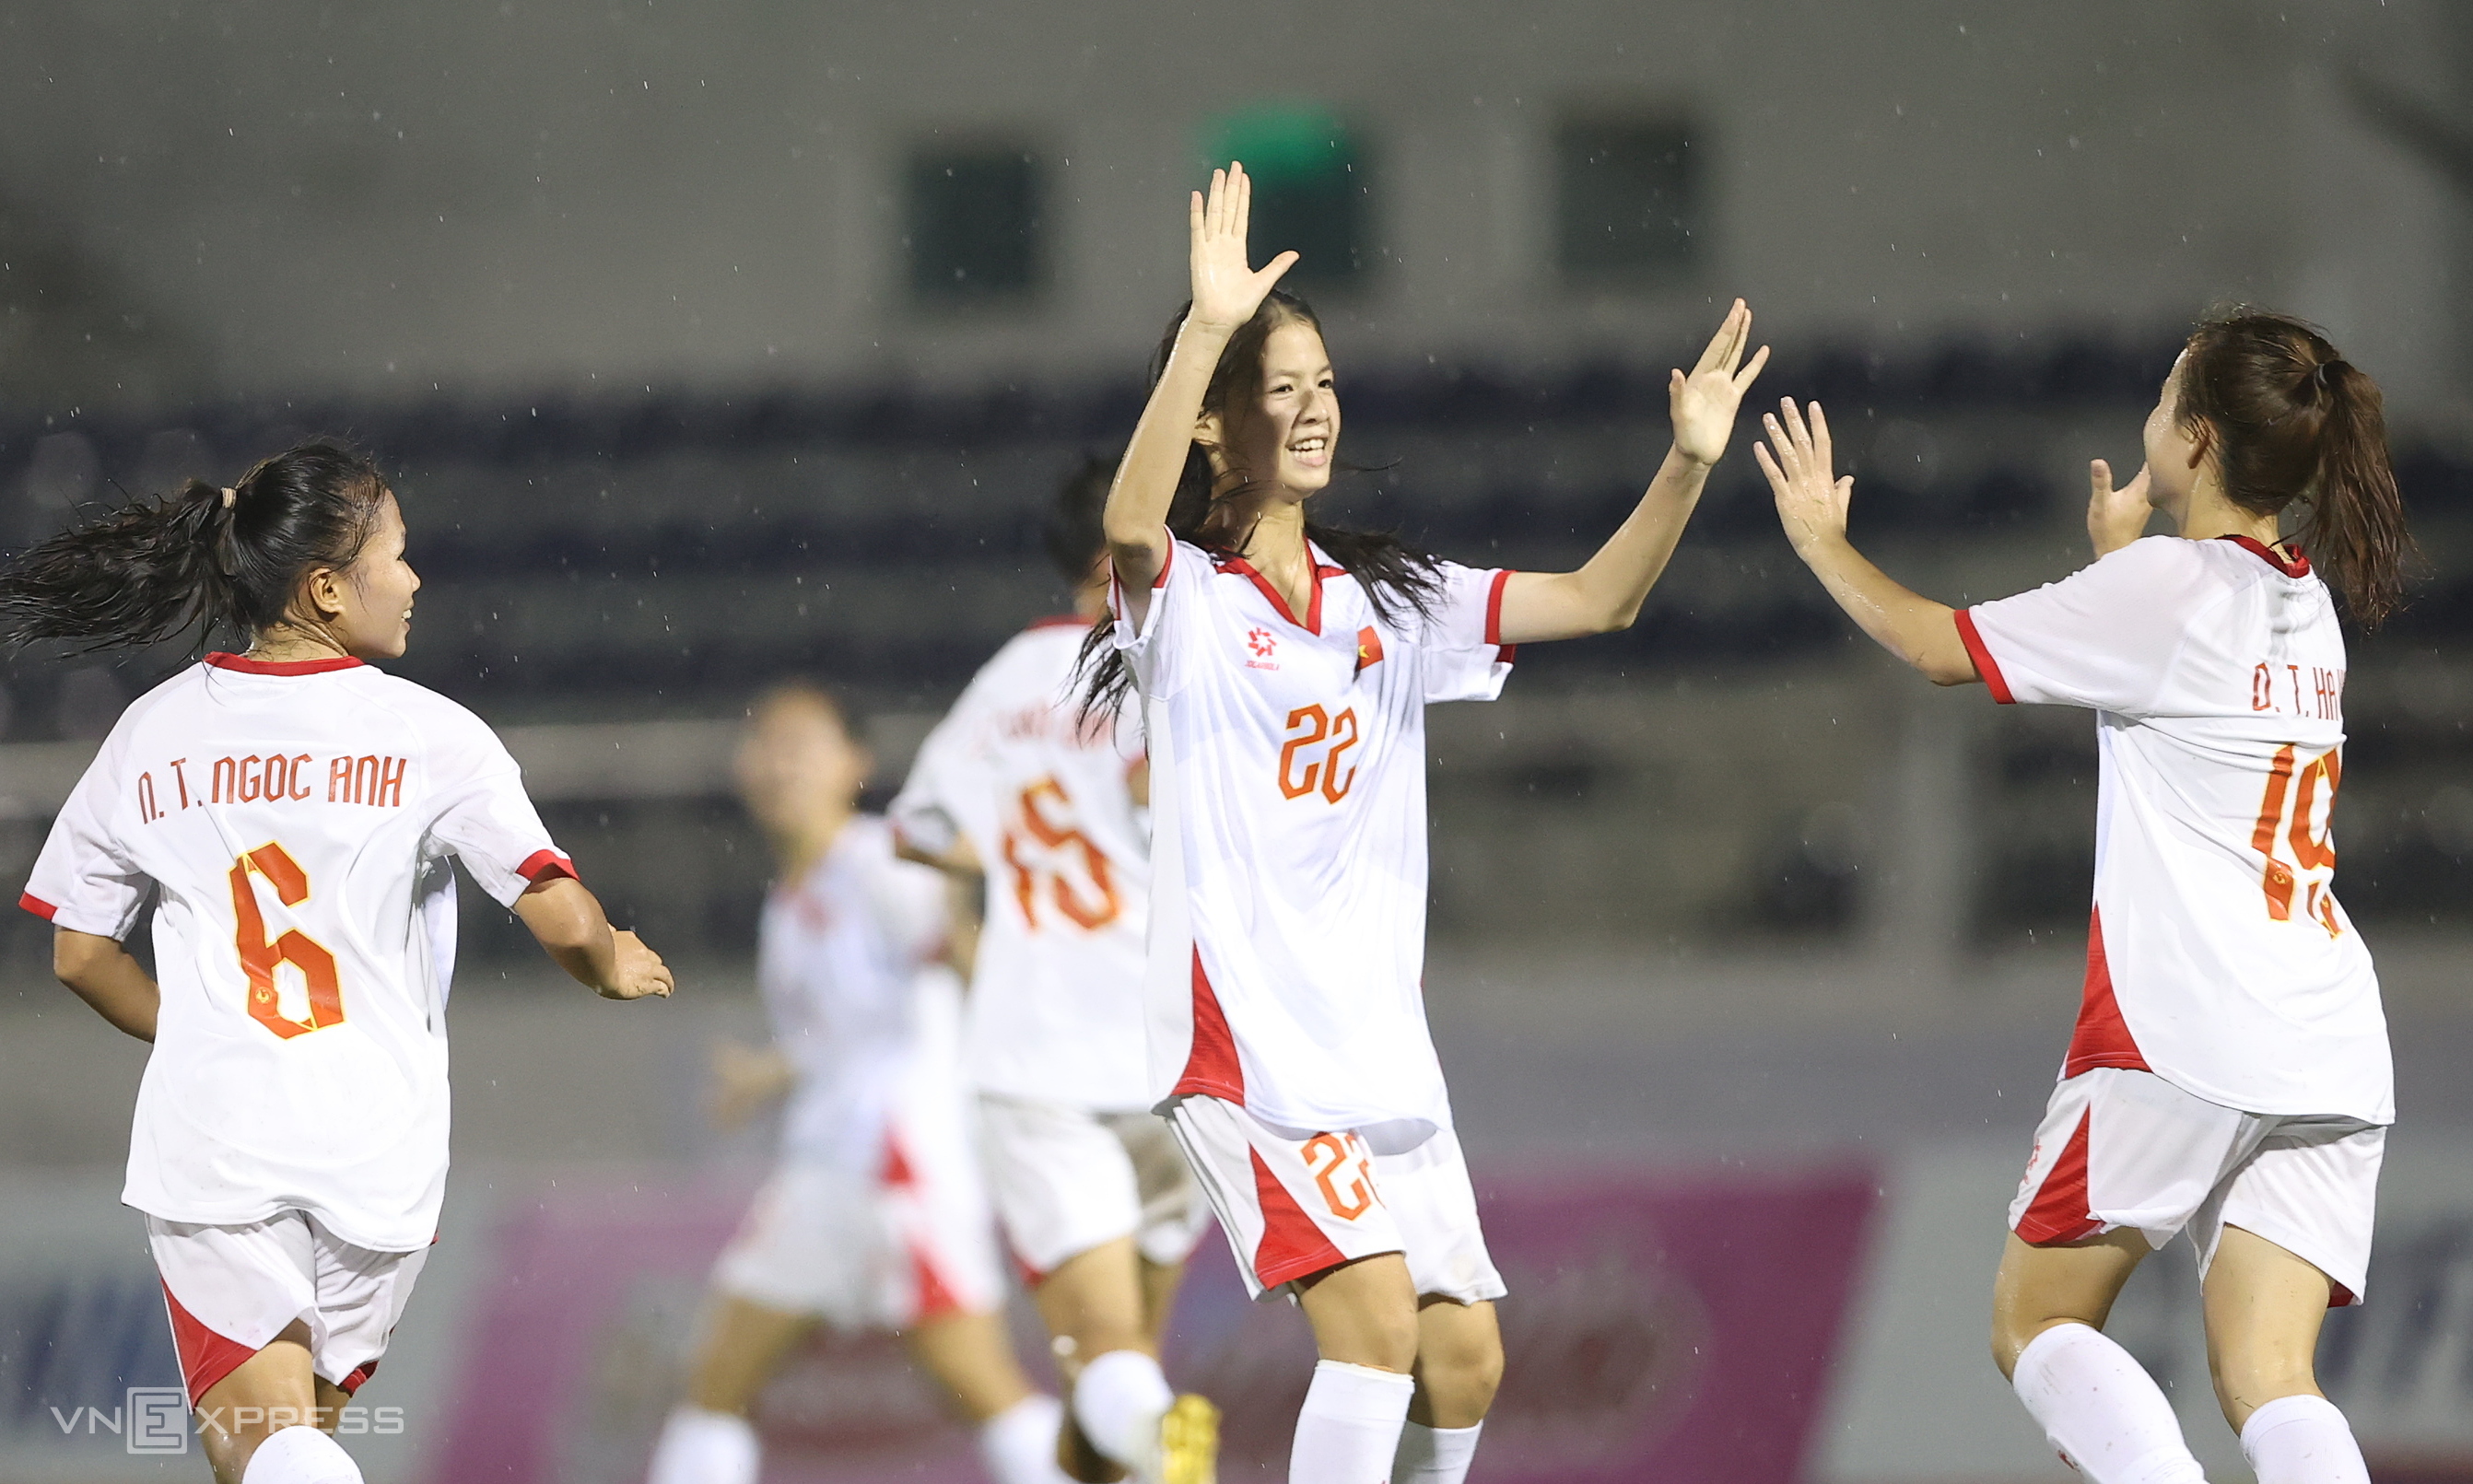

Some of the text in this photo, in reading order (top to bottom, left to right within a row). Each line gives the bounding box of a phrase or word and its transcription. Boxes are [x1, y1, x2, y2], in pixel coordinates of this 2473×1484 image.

[138, 753, 407, 824] N. T. NGOC ANH
[1279, 703, 1358, 804] 22
[229, 839, 347, 1040] 6
